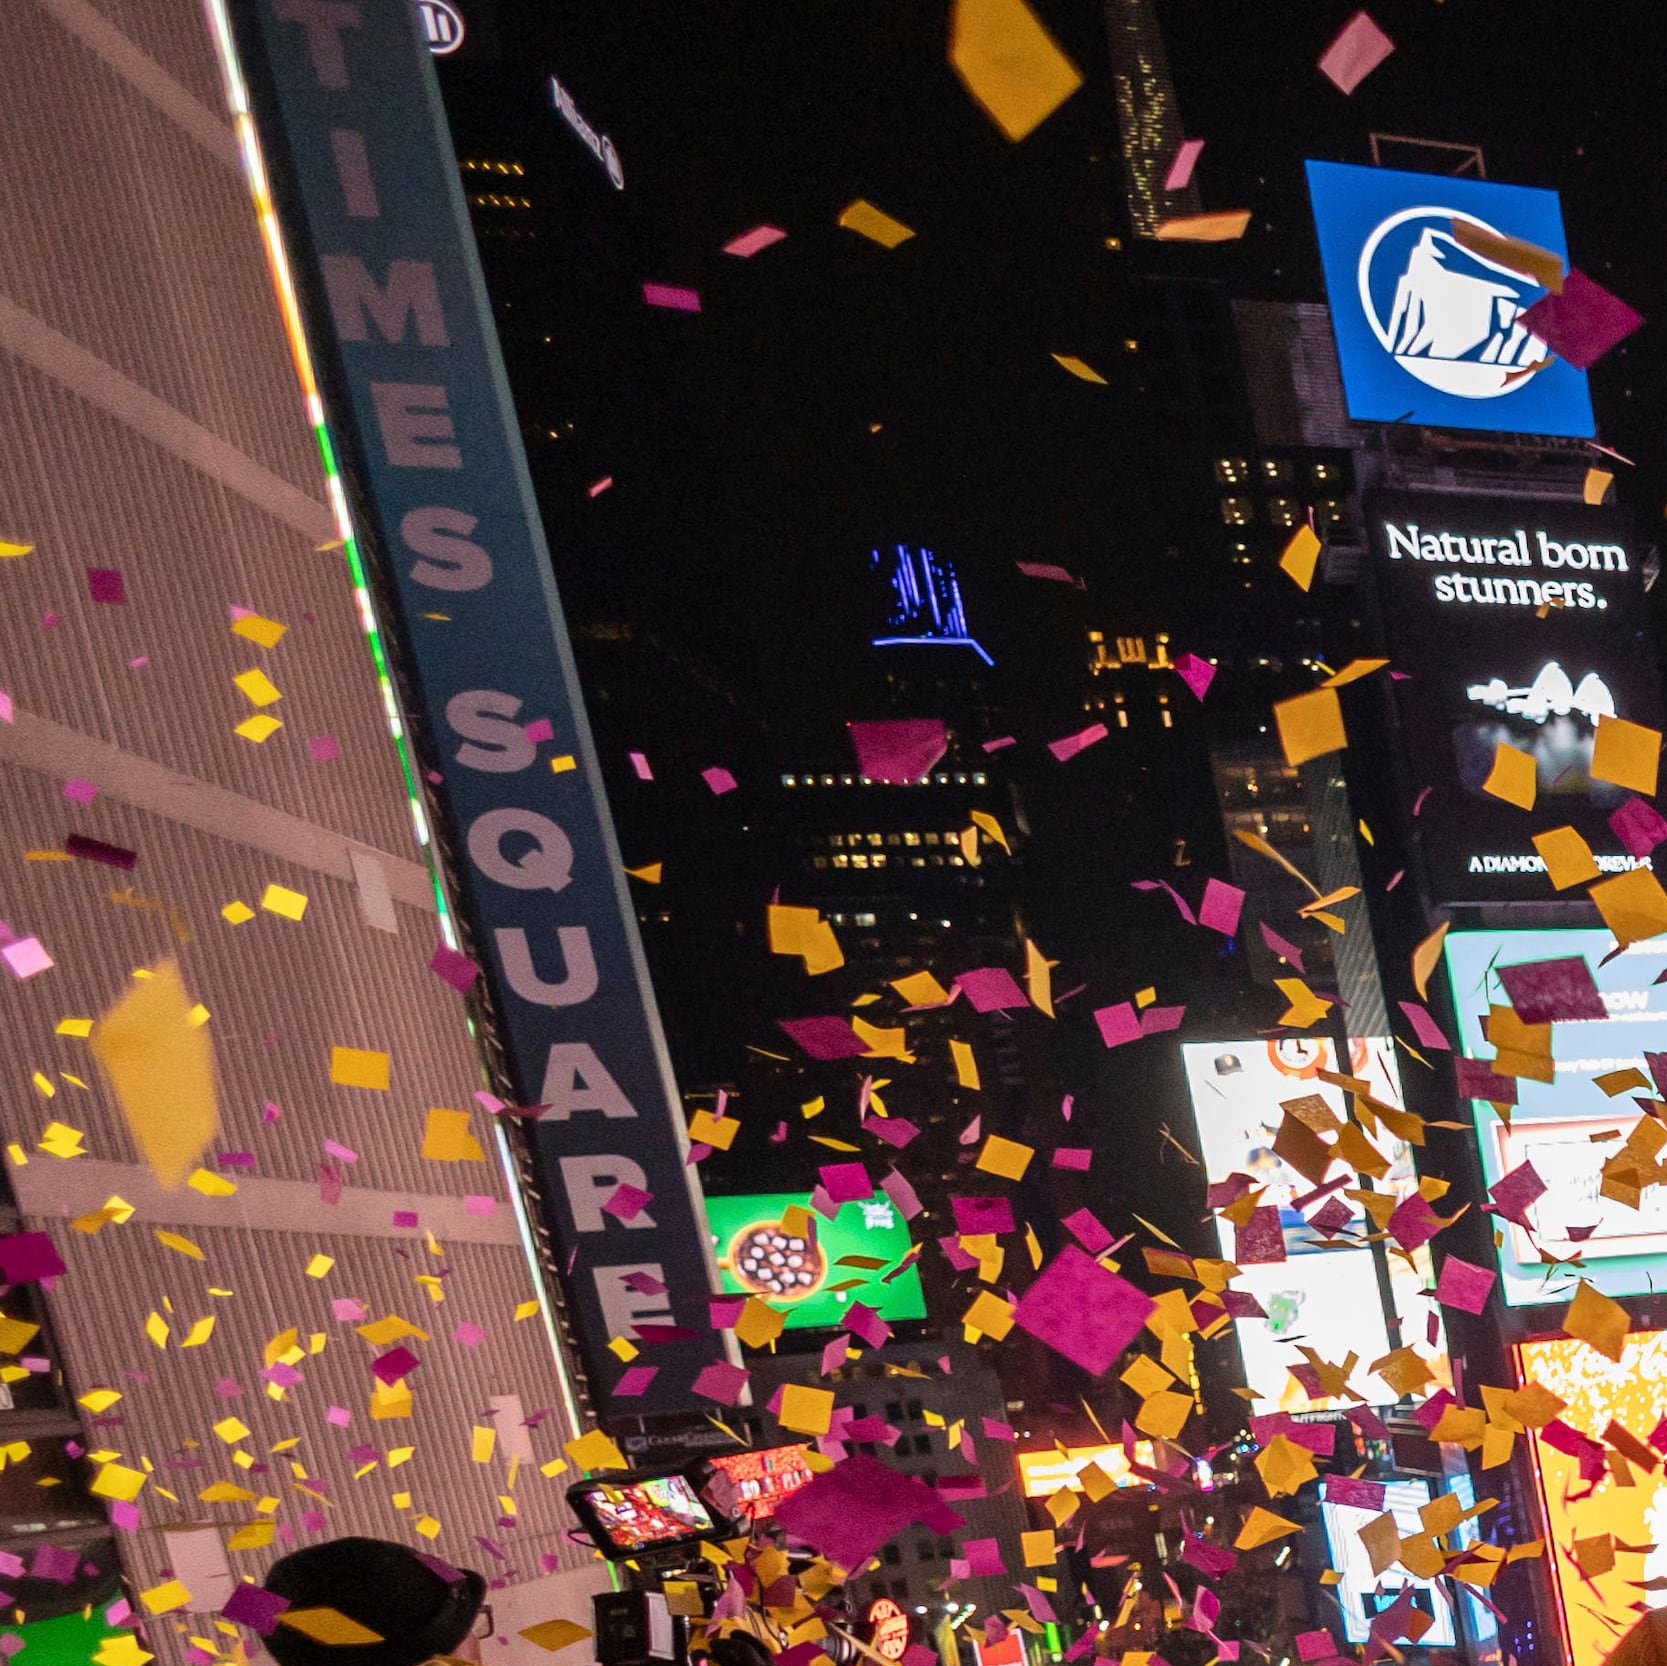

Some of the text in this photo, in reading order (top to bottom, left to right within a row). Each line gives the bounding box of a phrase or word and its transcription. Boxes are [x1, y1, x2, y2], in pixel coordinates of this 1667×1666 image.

[276, 3, 493, 592] TIMES
[1384, 521, 1532, 567] Natural
[1433, 572, 1608, 609] stunners.
[1484, 854, 1549, 873] DIAMON
[446, 689, 677, 1341] SQUARE
